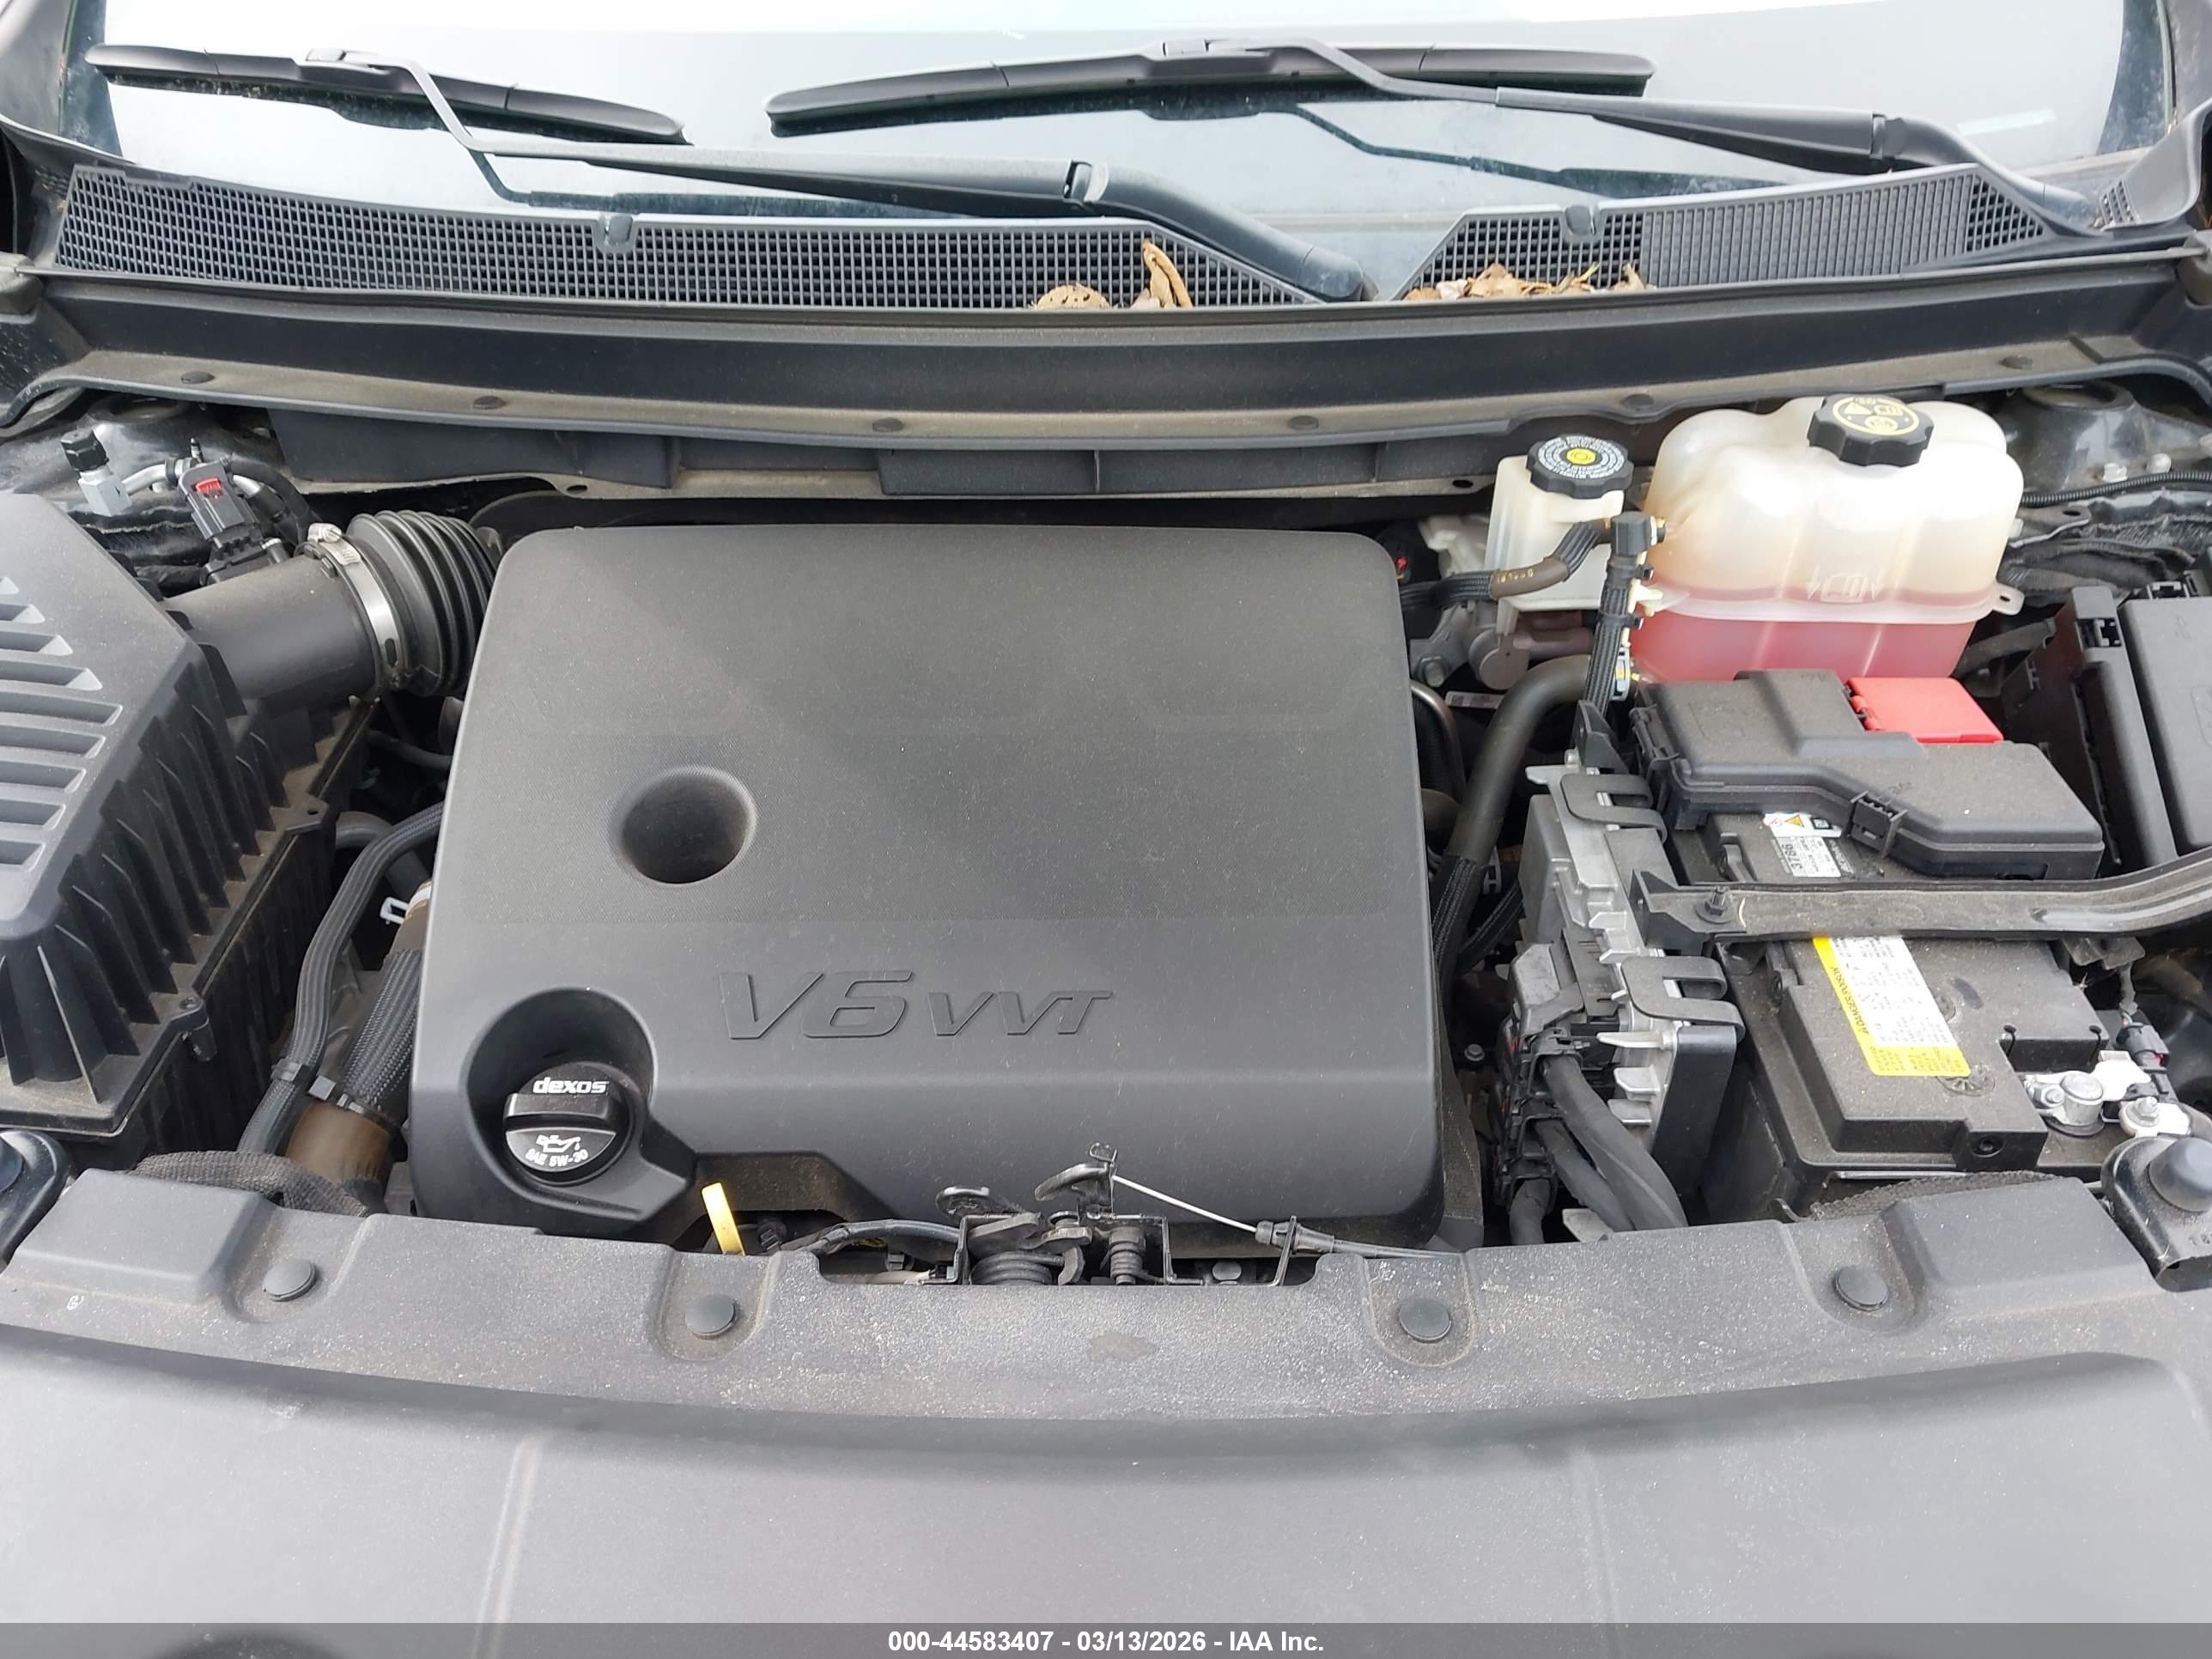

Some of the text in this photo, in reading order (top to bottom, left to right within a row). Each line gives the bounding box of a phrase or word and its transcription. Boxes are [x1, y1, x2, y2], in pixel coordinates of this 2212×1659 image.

[720, 970, 1113, 1039] V6 VVT
[533, 1077, 608, 1094] dexos
[526, 1149, 588, 1166] SAE 5W-30
